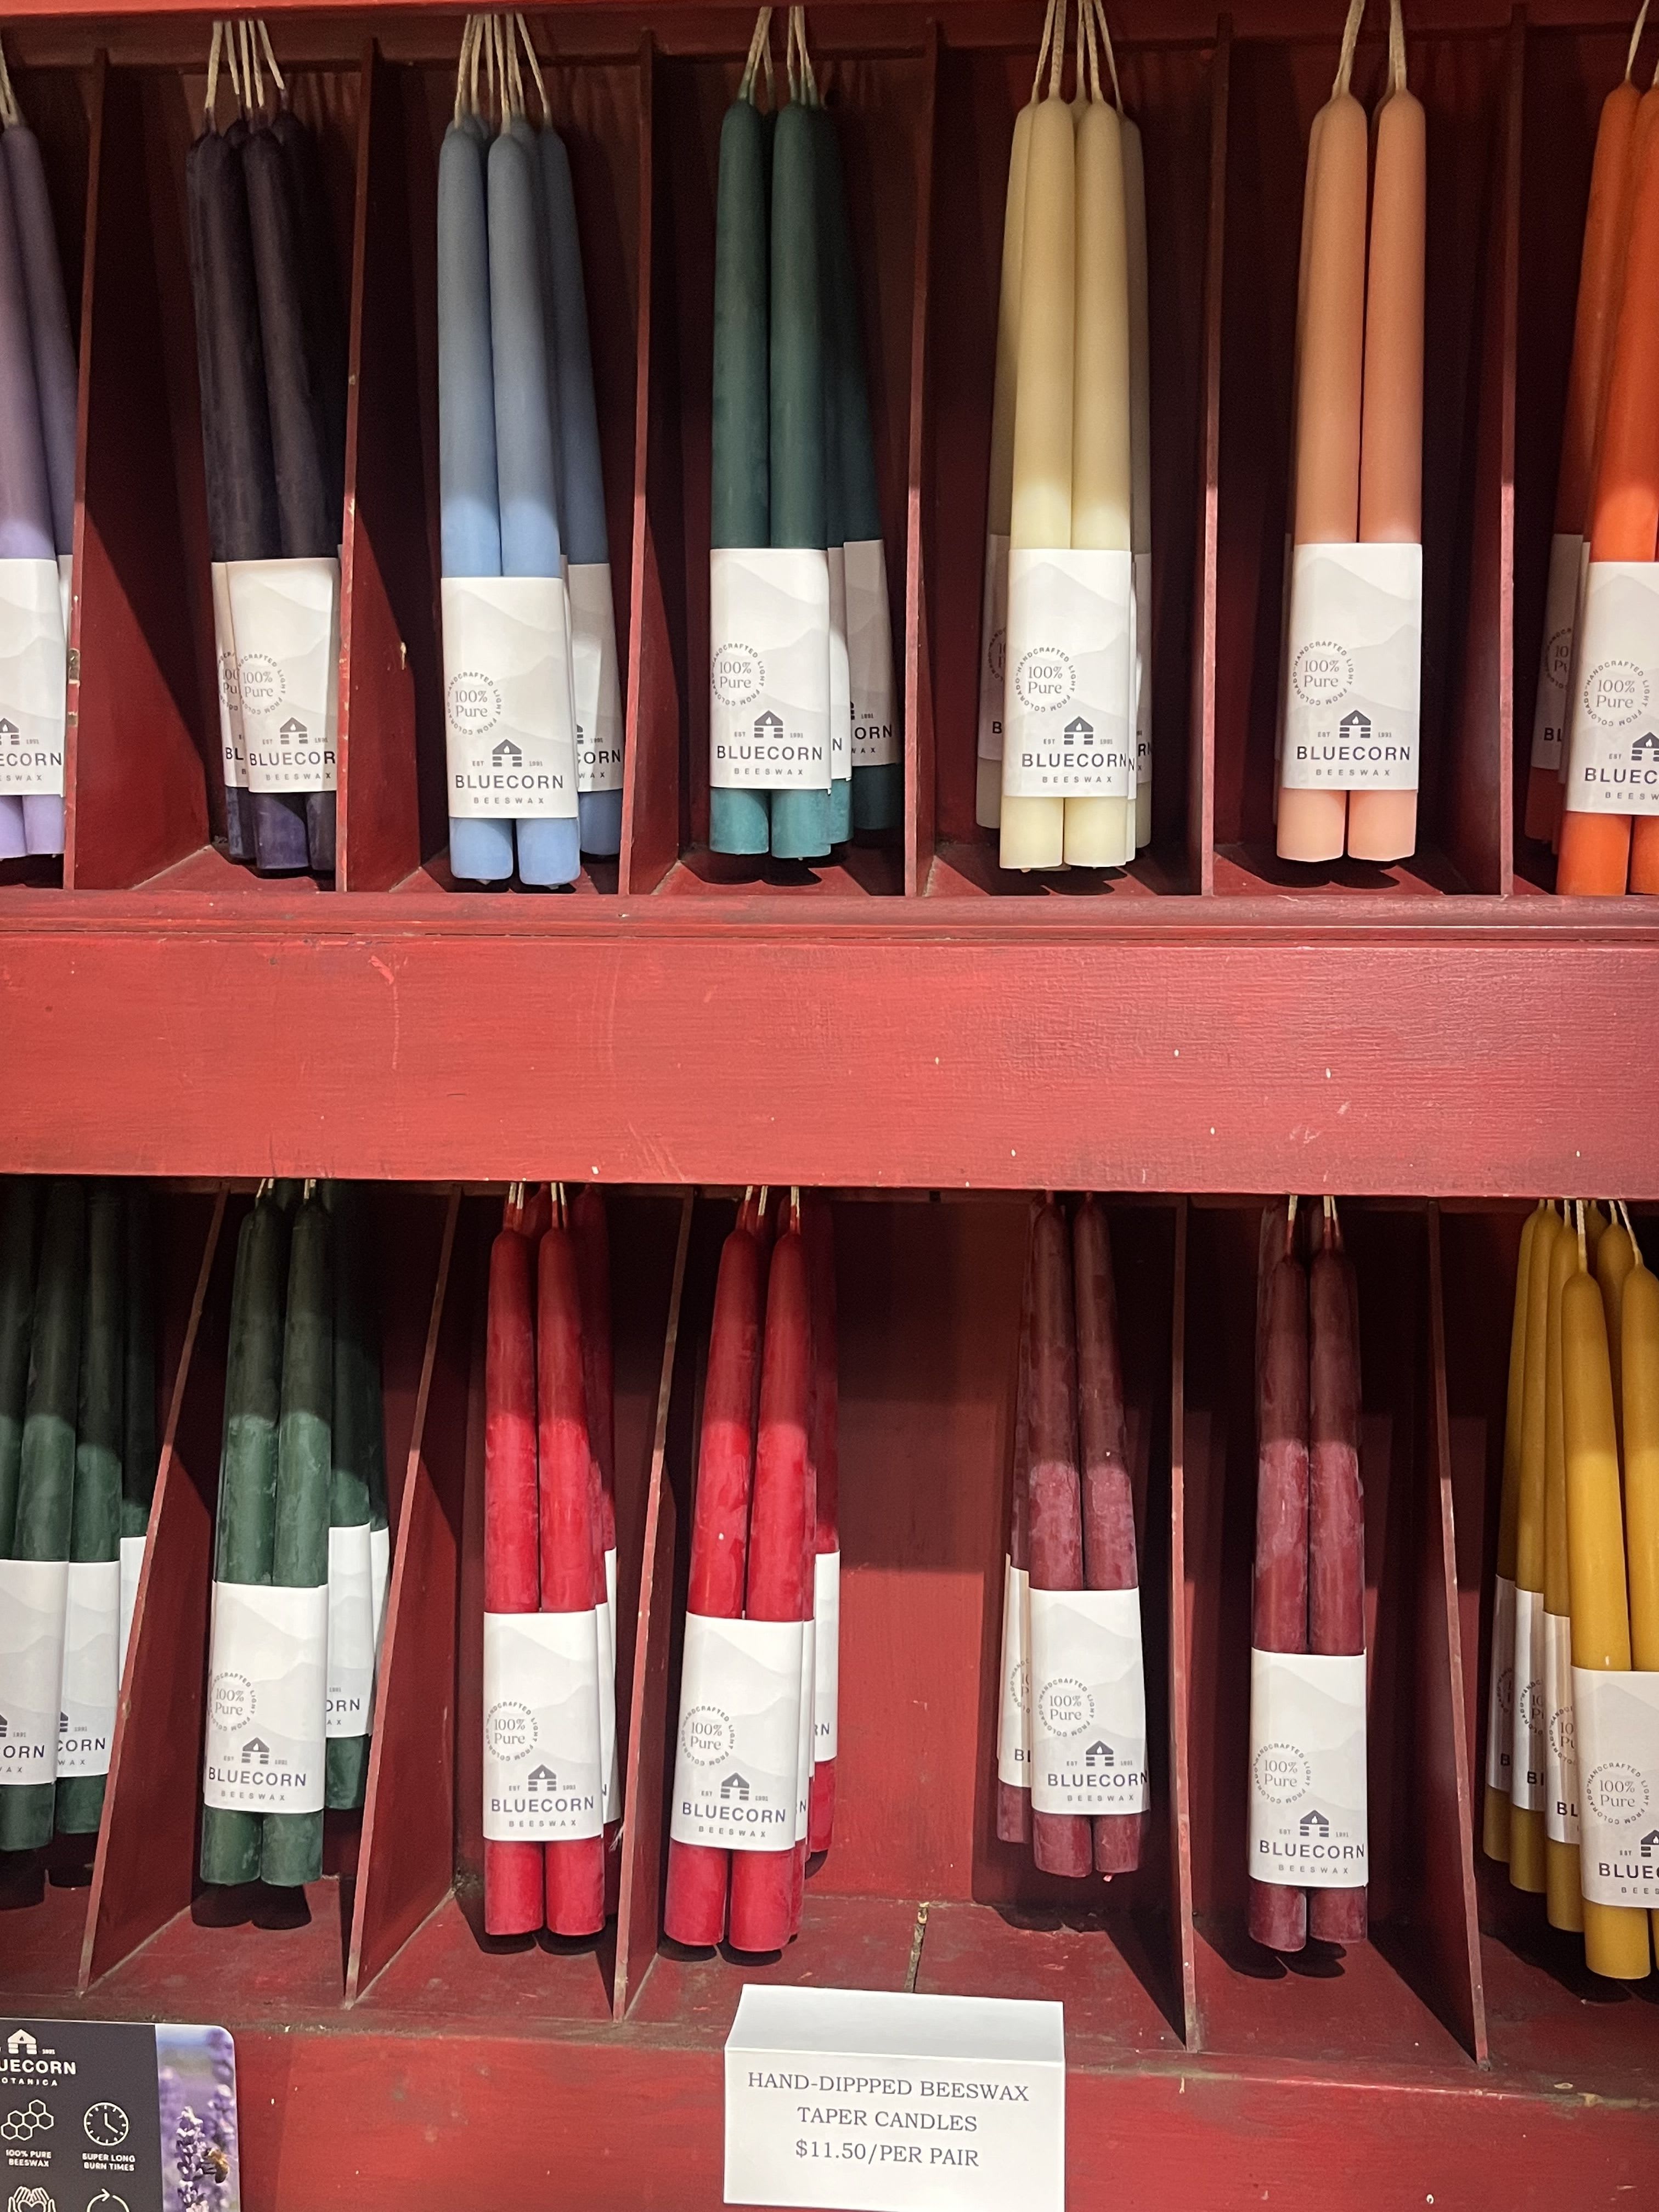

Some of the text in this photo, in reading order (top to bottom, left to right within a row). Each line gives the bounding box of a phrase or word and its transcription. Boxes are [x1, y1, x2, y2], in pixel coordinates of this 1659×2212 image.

[1018, 647, 1069, 672] HANDCRAFTED
[1295, 641, 1347, 666] HANDCRAFTED
[720, 662, 752, 674] 100%
[1029, 666, 1062, 679] 100%
[1305, 660, 1339, 672] 100%
[1588, 661, 1644, 685] HANDCRAFTED
[243, 672, 273, 684] 100%
[277, 669, 285, 693] LIGHT
[720, 676, 751, 688] Pure
[1304, 675, 1339, 687] Pure
[245, 686, 273, 697] Pure
[1028, 681, 1062, 693] Pure
[1293, 672, 1321, 706] COLORADO
[1598, 680, 1635, 693] 100%
[455, 690, 488, 702] 100%
[493, 689, 501, 714] LIGHT
[740, 689, 760, 705] FROM
[1015, 678, 1046, 712] COLORADO
[1325, 689, 1347, 704] FROM
[1596, 695, 1633, 708] Pure
[264, 697, 283, 713] FROM
[1050, 695, 1070, 711] FROM
[1584, 691, 1613, 726] COLORADO
[456, 705, 488, 717] Pure
[1620, 709, 1642, 726] FROM
[477, 718, 497, 734] FROM
[250, 751, 335, 766] BLUECOR
[718, 746, 822, 760] BLUECORN
[1297, 746, 1410, 760] BLUECORN
[1022, 754, 1126, 768] BLUECORN
[455, 775, 563, 788] BLUECORN
[1585, 768, 1657, 783] BLUEC
[216, 1688, 244, 1702] 100%
[1050, 1695, 1081, 1707] 100%
[215, 1702, 242, 1716] Pure
[1050, 1709, 1081, 1720] Pure
[231, 1717, 250, 1731] FROM
[494, 1719, 525, 1730] 100%
[691, 1722, 722, 1736] 100%
[1071, 1720, 1090, 1736] FROM
[58, 1738, 105, 1751] CORN
[494, 1733, 525, 1744] Pure
[691, 1736, 721, 1750] Pure
[515, 1744, 533, 1760] FROM
[709, 1751, 729, 1765] FROM
[1265, 1760, 1297, 1773] 100%
[209, 1767, 306, 1786] BLUECORN
[1048, 1770, 1147, 1787] BLUECORN
[1265, 1773, 1297, 1787] Pure
[1600, 1780, 1635, 1792] 100%
[221, 1791, 285, 1801] BEESWAX
[1286, 1788, 1306, 1803] FROM
[1587, 1763, 1649, 1825] HANDCRAFTED LIGHT FROM COLORADO
[1600, 1795, 1635, 1807] Pure
[492, 1796, 593, 1812] BLUECORN
[683, 1802, 786, 1822] BLUECORN
[699, 1826, 765, 1837] BEESWAX
[1260, 1840, 1364, 1859] BLUECORN
[1279, 1865, 1347, 1874] BEESWAX
[1599, 1863, 1659, 1878] BLUE
[0, 2059, 76, 2074] UECORN
[2, 2077, 58, 2086] OTANICA
[748, 2072, 1029, 2101] HAND-DIPPPED BEESWAX
[798, 2107, 977, 2132] TAPER CANDLES
[30, 2151, 52, 2159] PURE
[795, 2138, 979, 2166] $11.50/PER PAIR
[9, 2159, 49, 2167] BEESWAX
